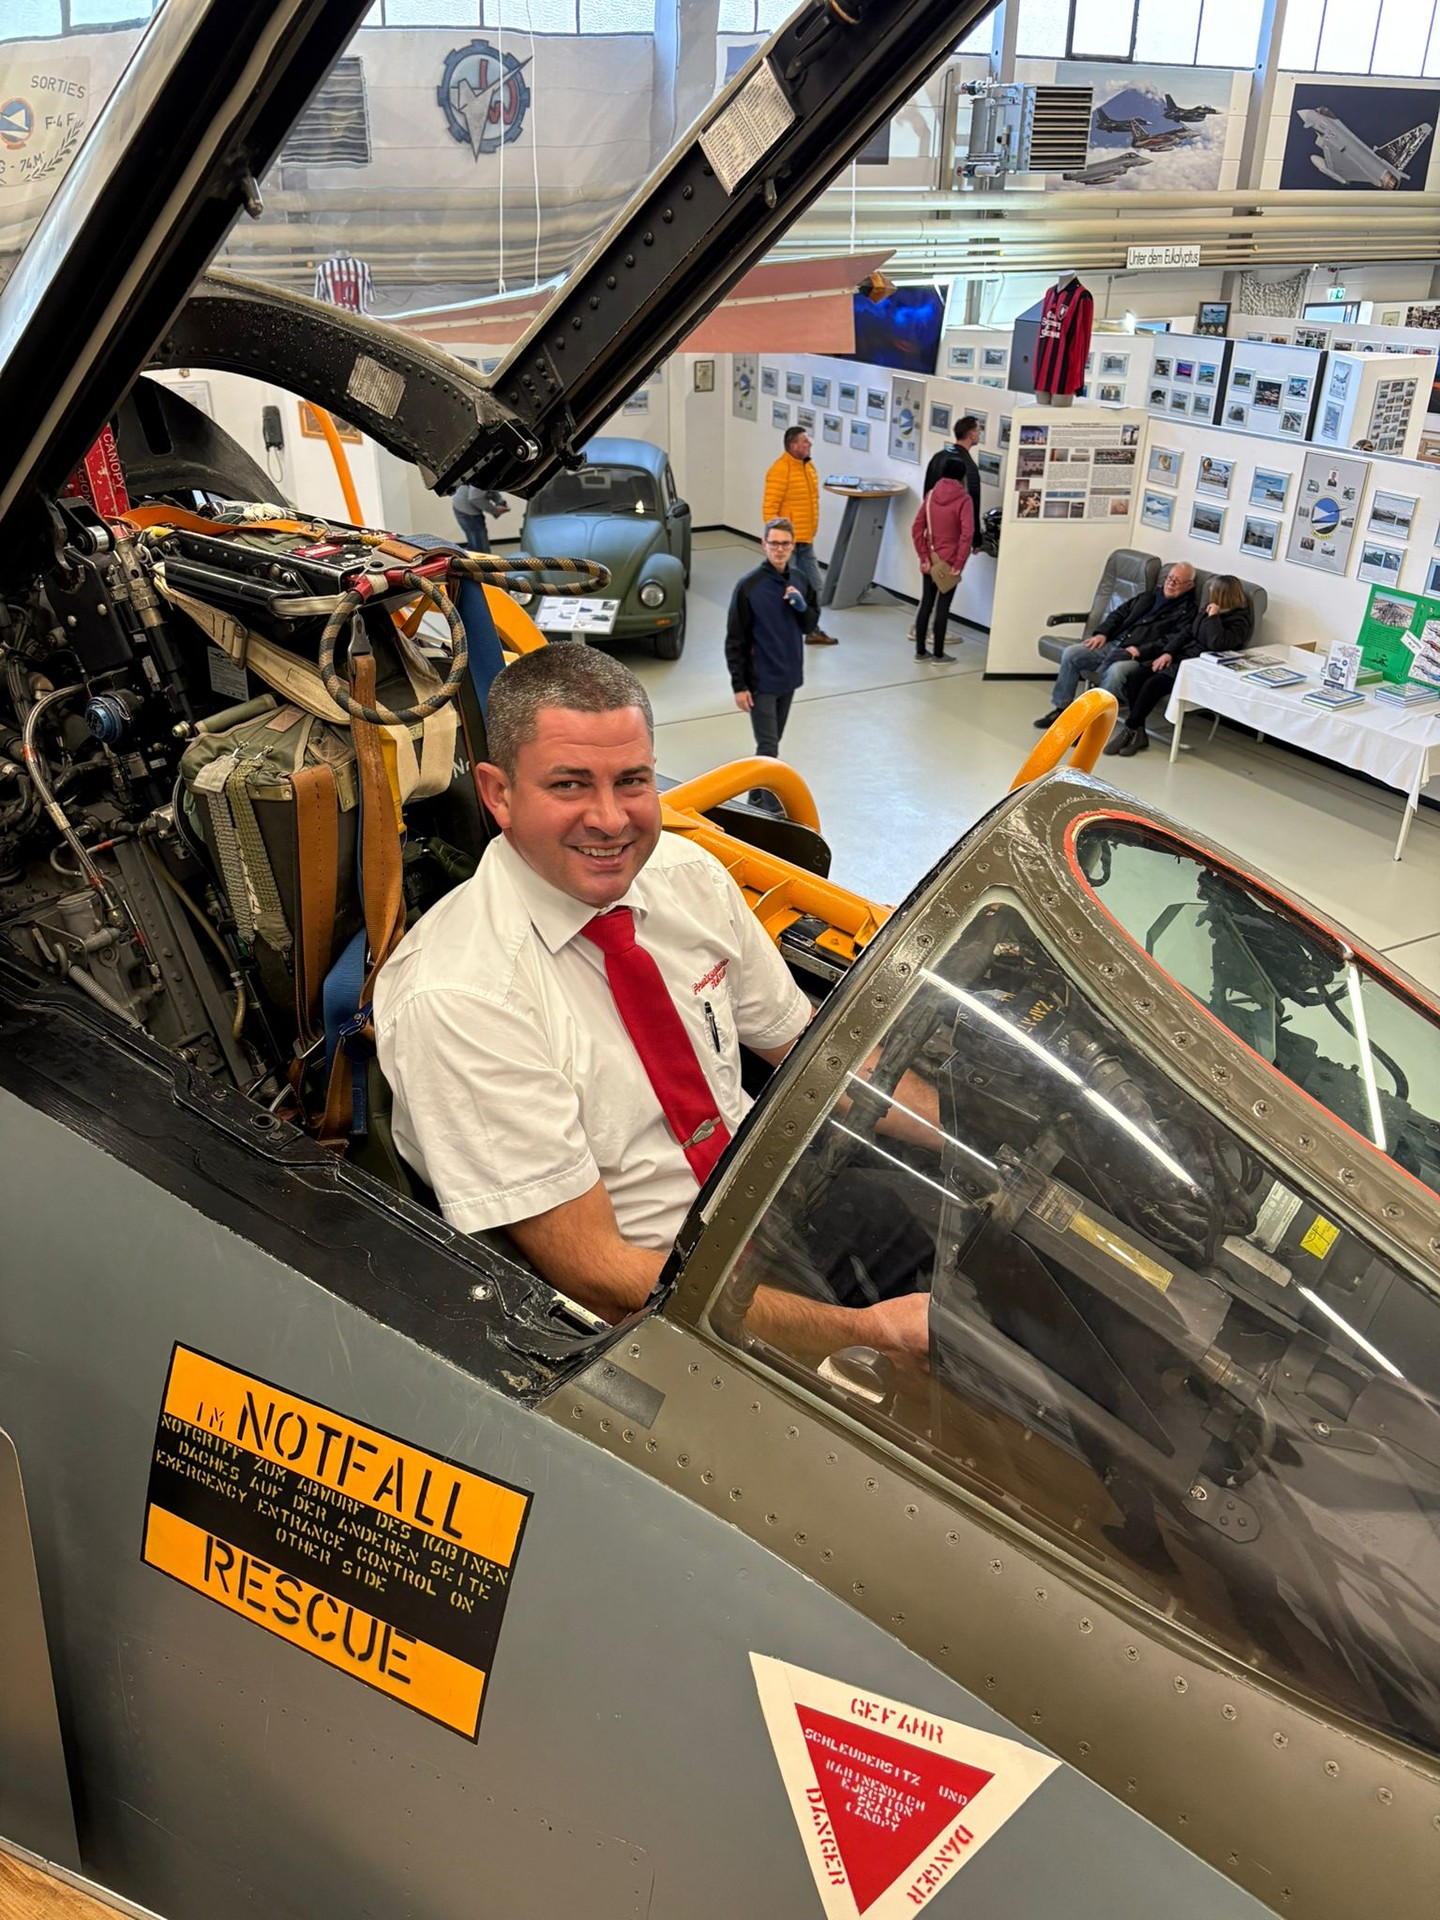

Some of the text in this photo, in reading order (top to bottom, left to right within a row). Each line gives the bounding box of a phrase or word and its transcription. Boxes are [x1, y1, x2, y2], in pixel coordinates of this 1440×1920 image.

[30, 75, 87, 99] SORTIES
[1128, 247, 1199, 268] Unter dem Eukalyptus
[102, 432, 126, 490] CANOPY
[160, 1414, 510, 1586] NOTGRIFF ZUM ABWURF DES KABINEN
[237, 1390, 464, 1539] NOTFALL
[155, 1449, 475, 1614] EMERGENCY ENTRANCE CONTROL ON
[177, 1440, 492, 1601] DACHES AUF DER ANDEREN SEITE
[275, 1528, 388, 1594] OTHER SIDE
[202, 1534, 417, 1686] RESCUE
[850, 1697, 944, 1745] GEFAHR
[804, 1728, 968, 1806] SCHLEUDERSITZ UND
[840, 1777, 913, 1819] EJECTION
[805, 1786, 847, 1886] DANGER
[845, 1801, 900, 1833] CANOPY
[906, 1823, 974, 1906] DANGER
